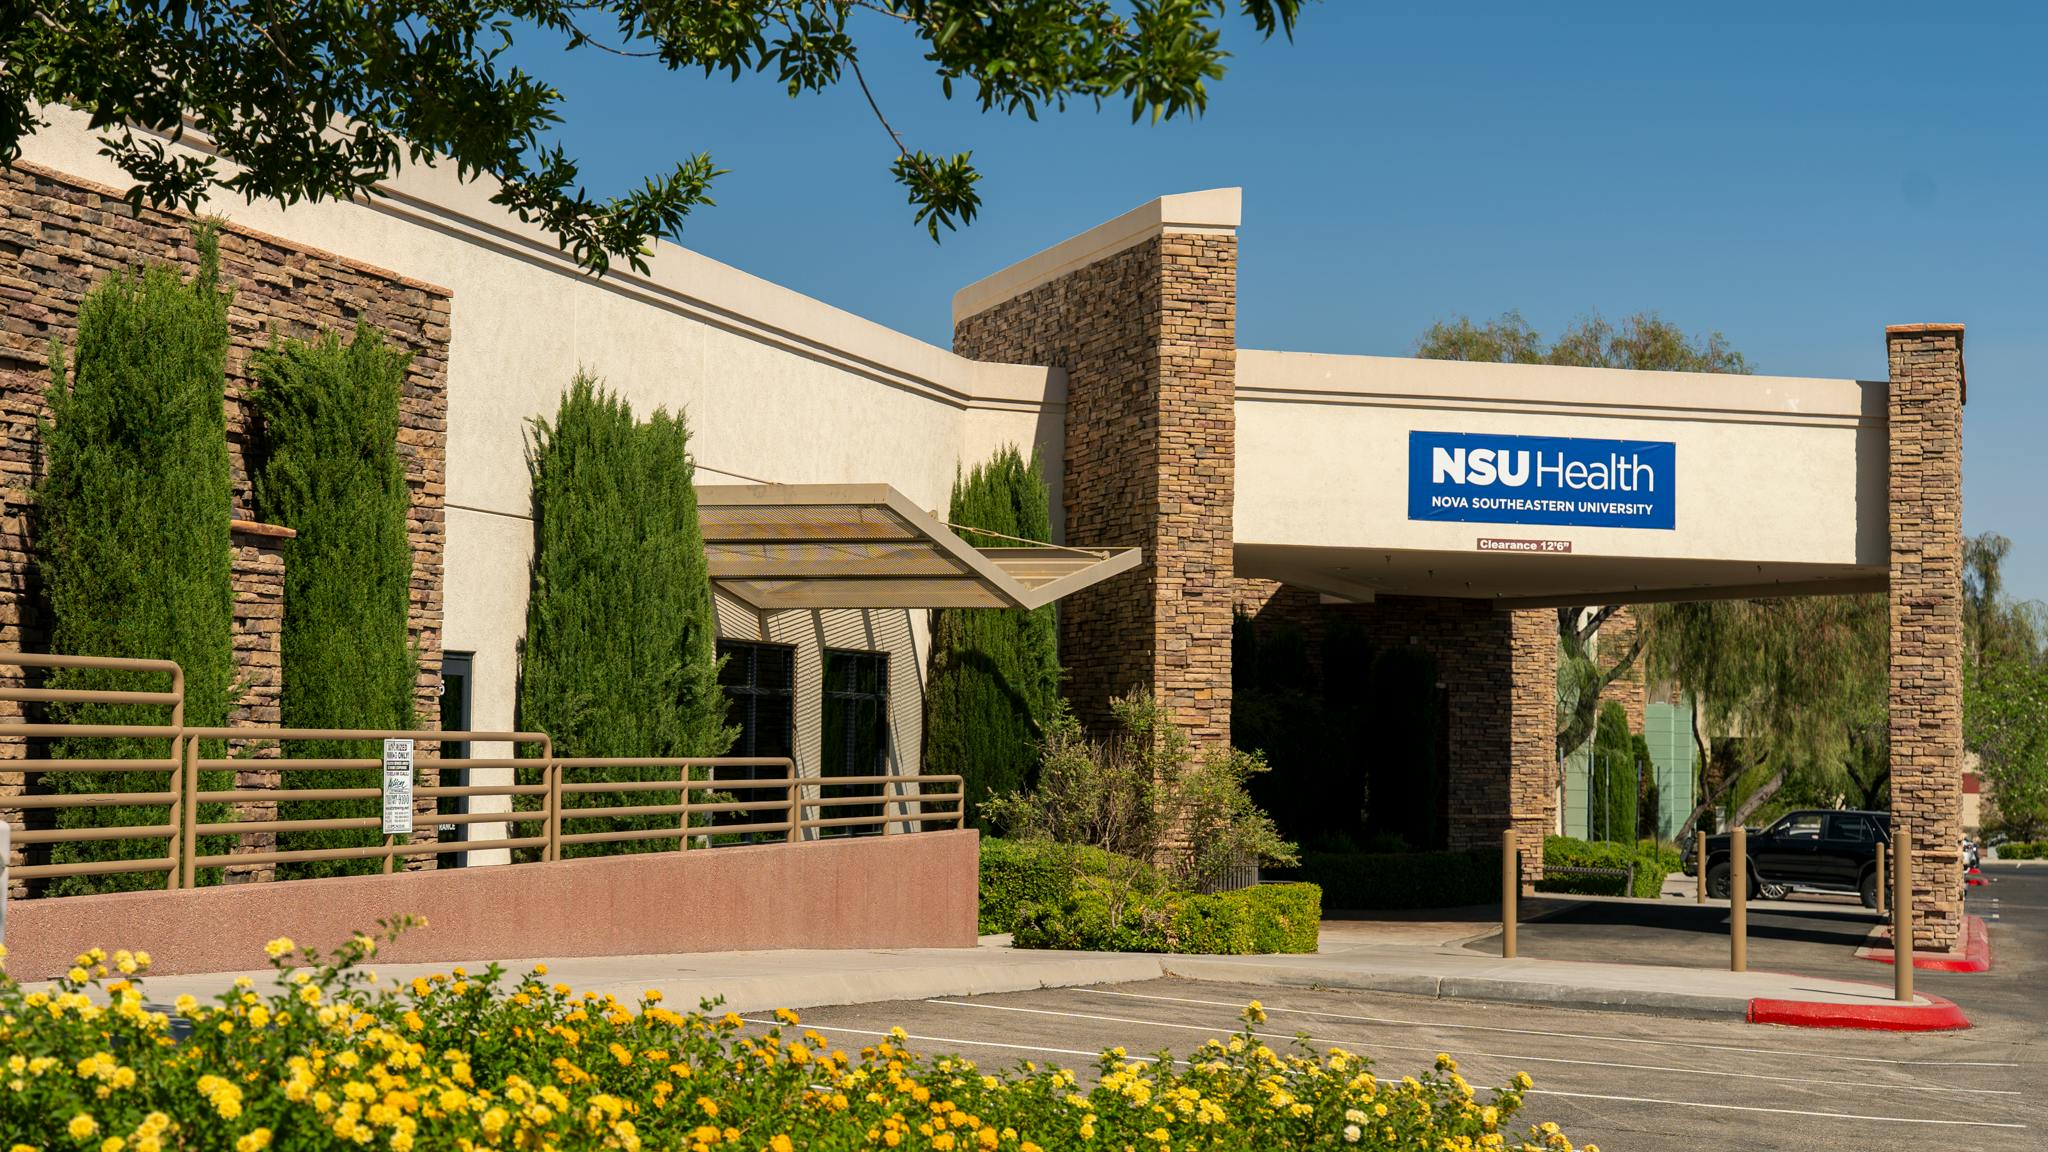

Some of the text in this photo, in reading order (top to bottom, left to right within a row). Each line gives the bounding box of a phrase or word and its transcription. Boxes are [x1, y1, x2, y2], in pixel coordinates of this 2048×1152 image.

[1432, 447, 1654, 492] NSU Health
[1432, 496, 1653, 515] NOVA SOUTHEASTERN UNIVERSITY
[1480, 540, 1537, 550] Clearance
